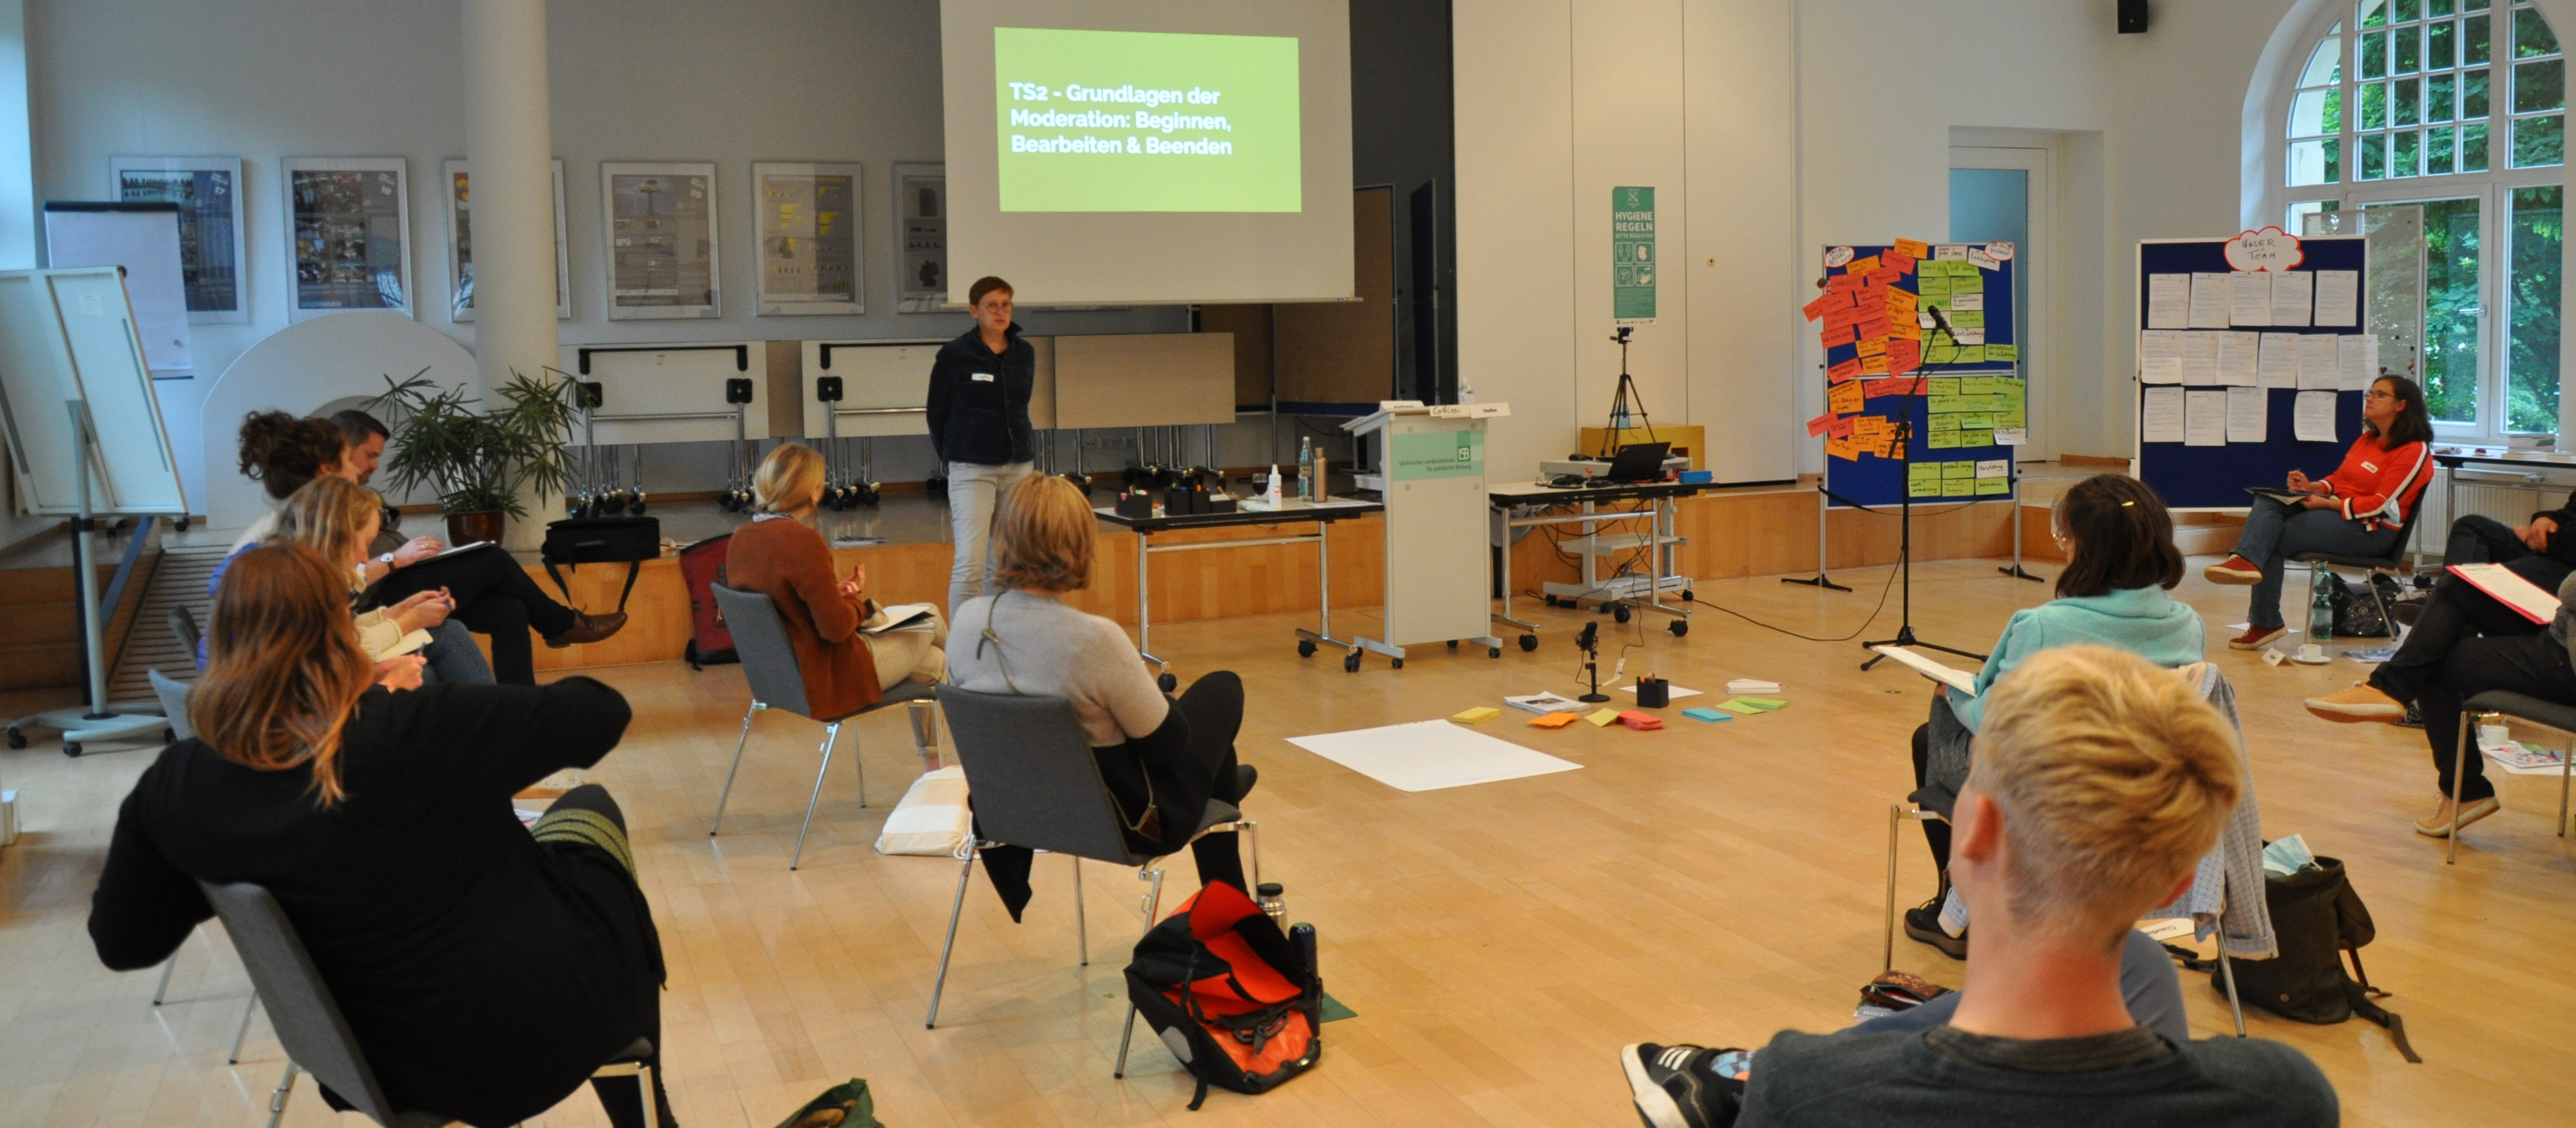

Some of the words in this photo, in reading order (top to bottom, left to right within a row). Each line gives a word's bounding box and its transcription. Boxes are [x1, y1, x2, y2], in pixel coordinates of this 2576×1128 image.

[1009, 82, 1048, 101] TS2
[1066, 84, 1183, 108] Grundlagen
[1187, 87, 1220, 105] der
[1010, 109, 1131, 128] Moderation:
[1135, 111, 1232, 133] Beginnen,
[1012, 135, 1122, 154] Bearbeiten
[1126, 137, 1141, 154] &
[1146, 137, 1233, 155] Beenden
[1615, 212, 1653, 221] HYGIENE
[1616, 222, 1653, 231] REGELN
